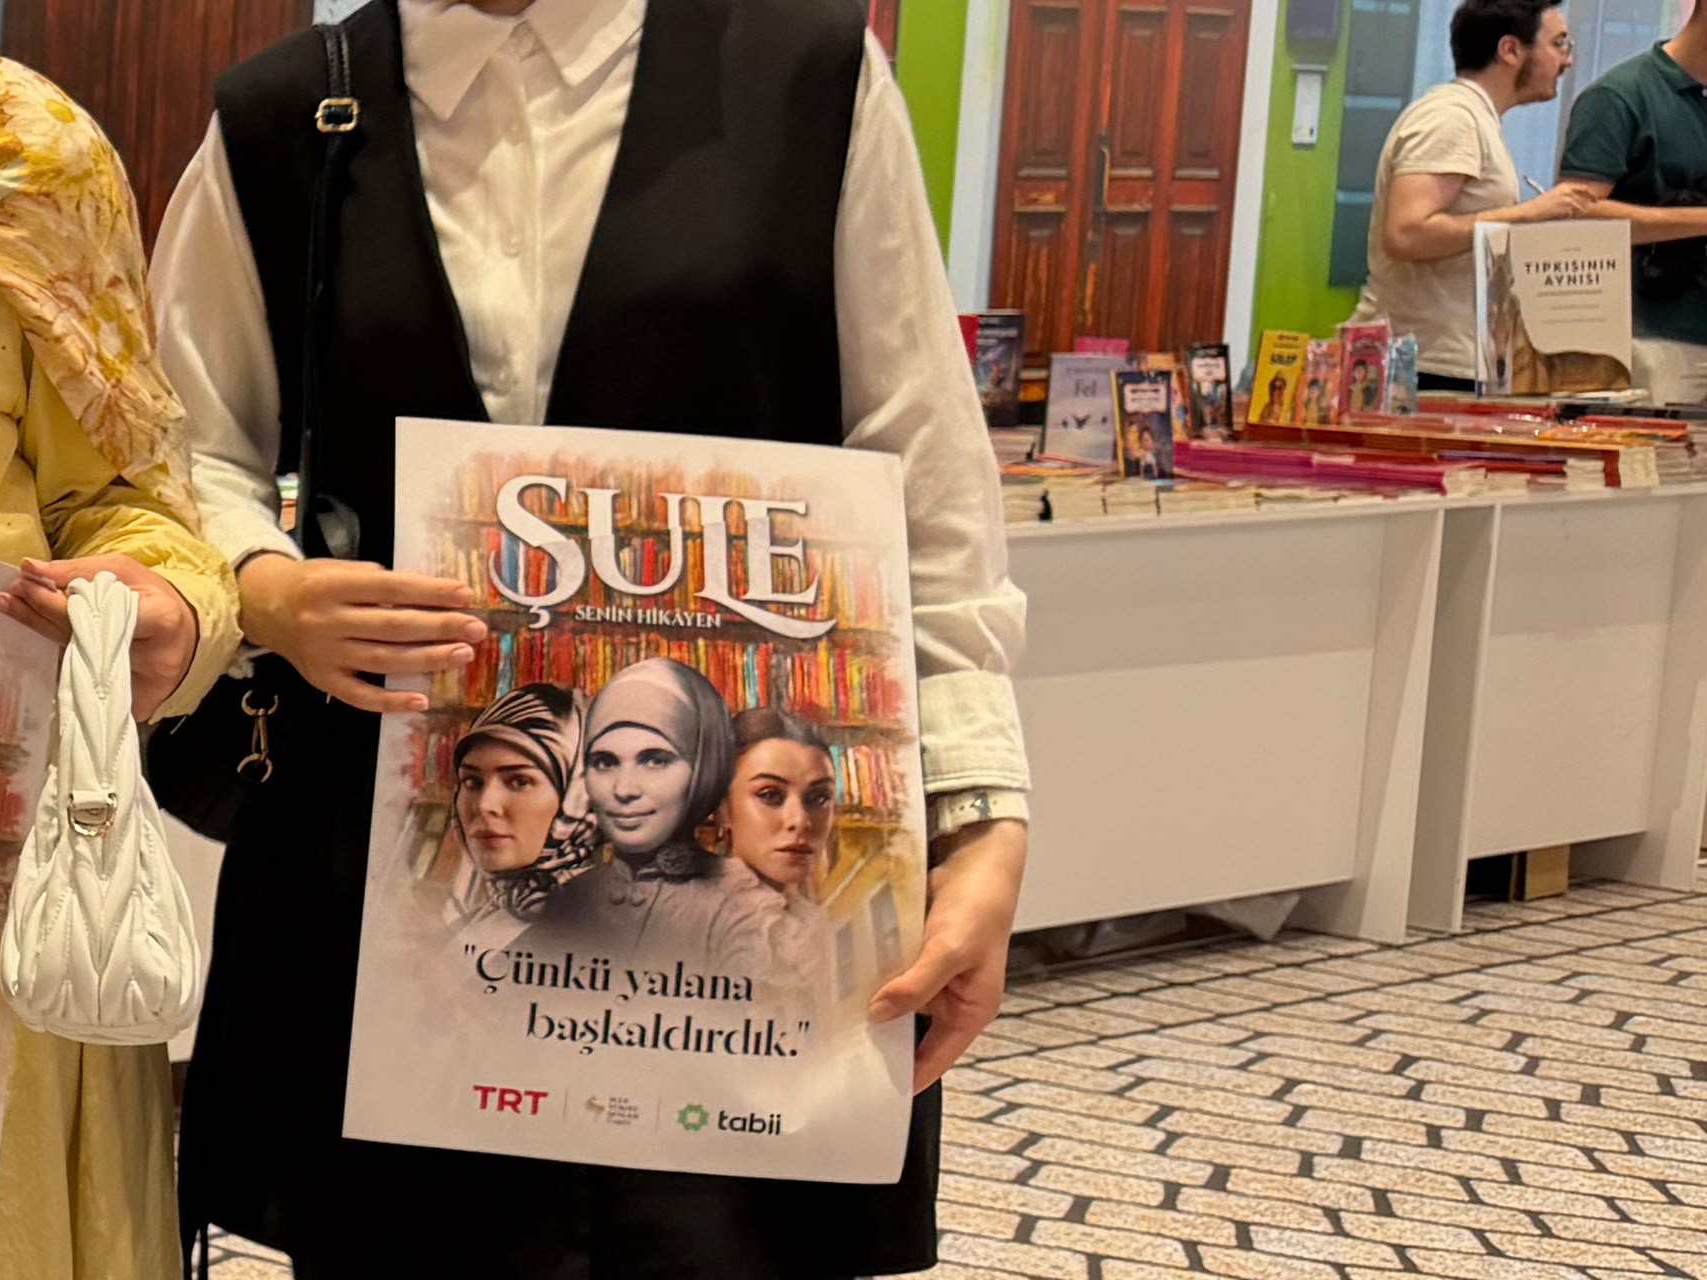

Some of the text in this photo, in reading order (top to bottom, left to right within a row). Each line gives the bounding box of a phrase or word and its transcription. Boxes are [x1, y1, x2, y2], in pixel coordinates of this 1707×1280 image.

[489, 475, 836, 639] ŞULE
[575, 604, 721, 629] SENİN HİKÂYEN
[464, 944, 753, 1001] "Çünkü yalana
[526, 1002, 810, 1057] başkaldırdık."
[473, 1084, 782, 1136] TRT tabii
